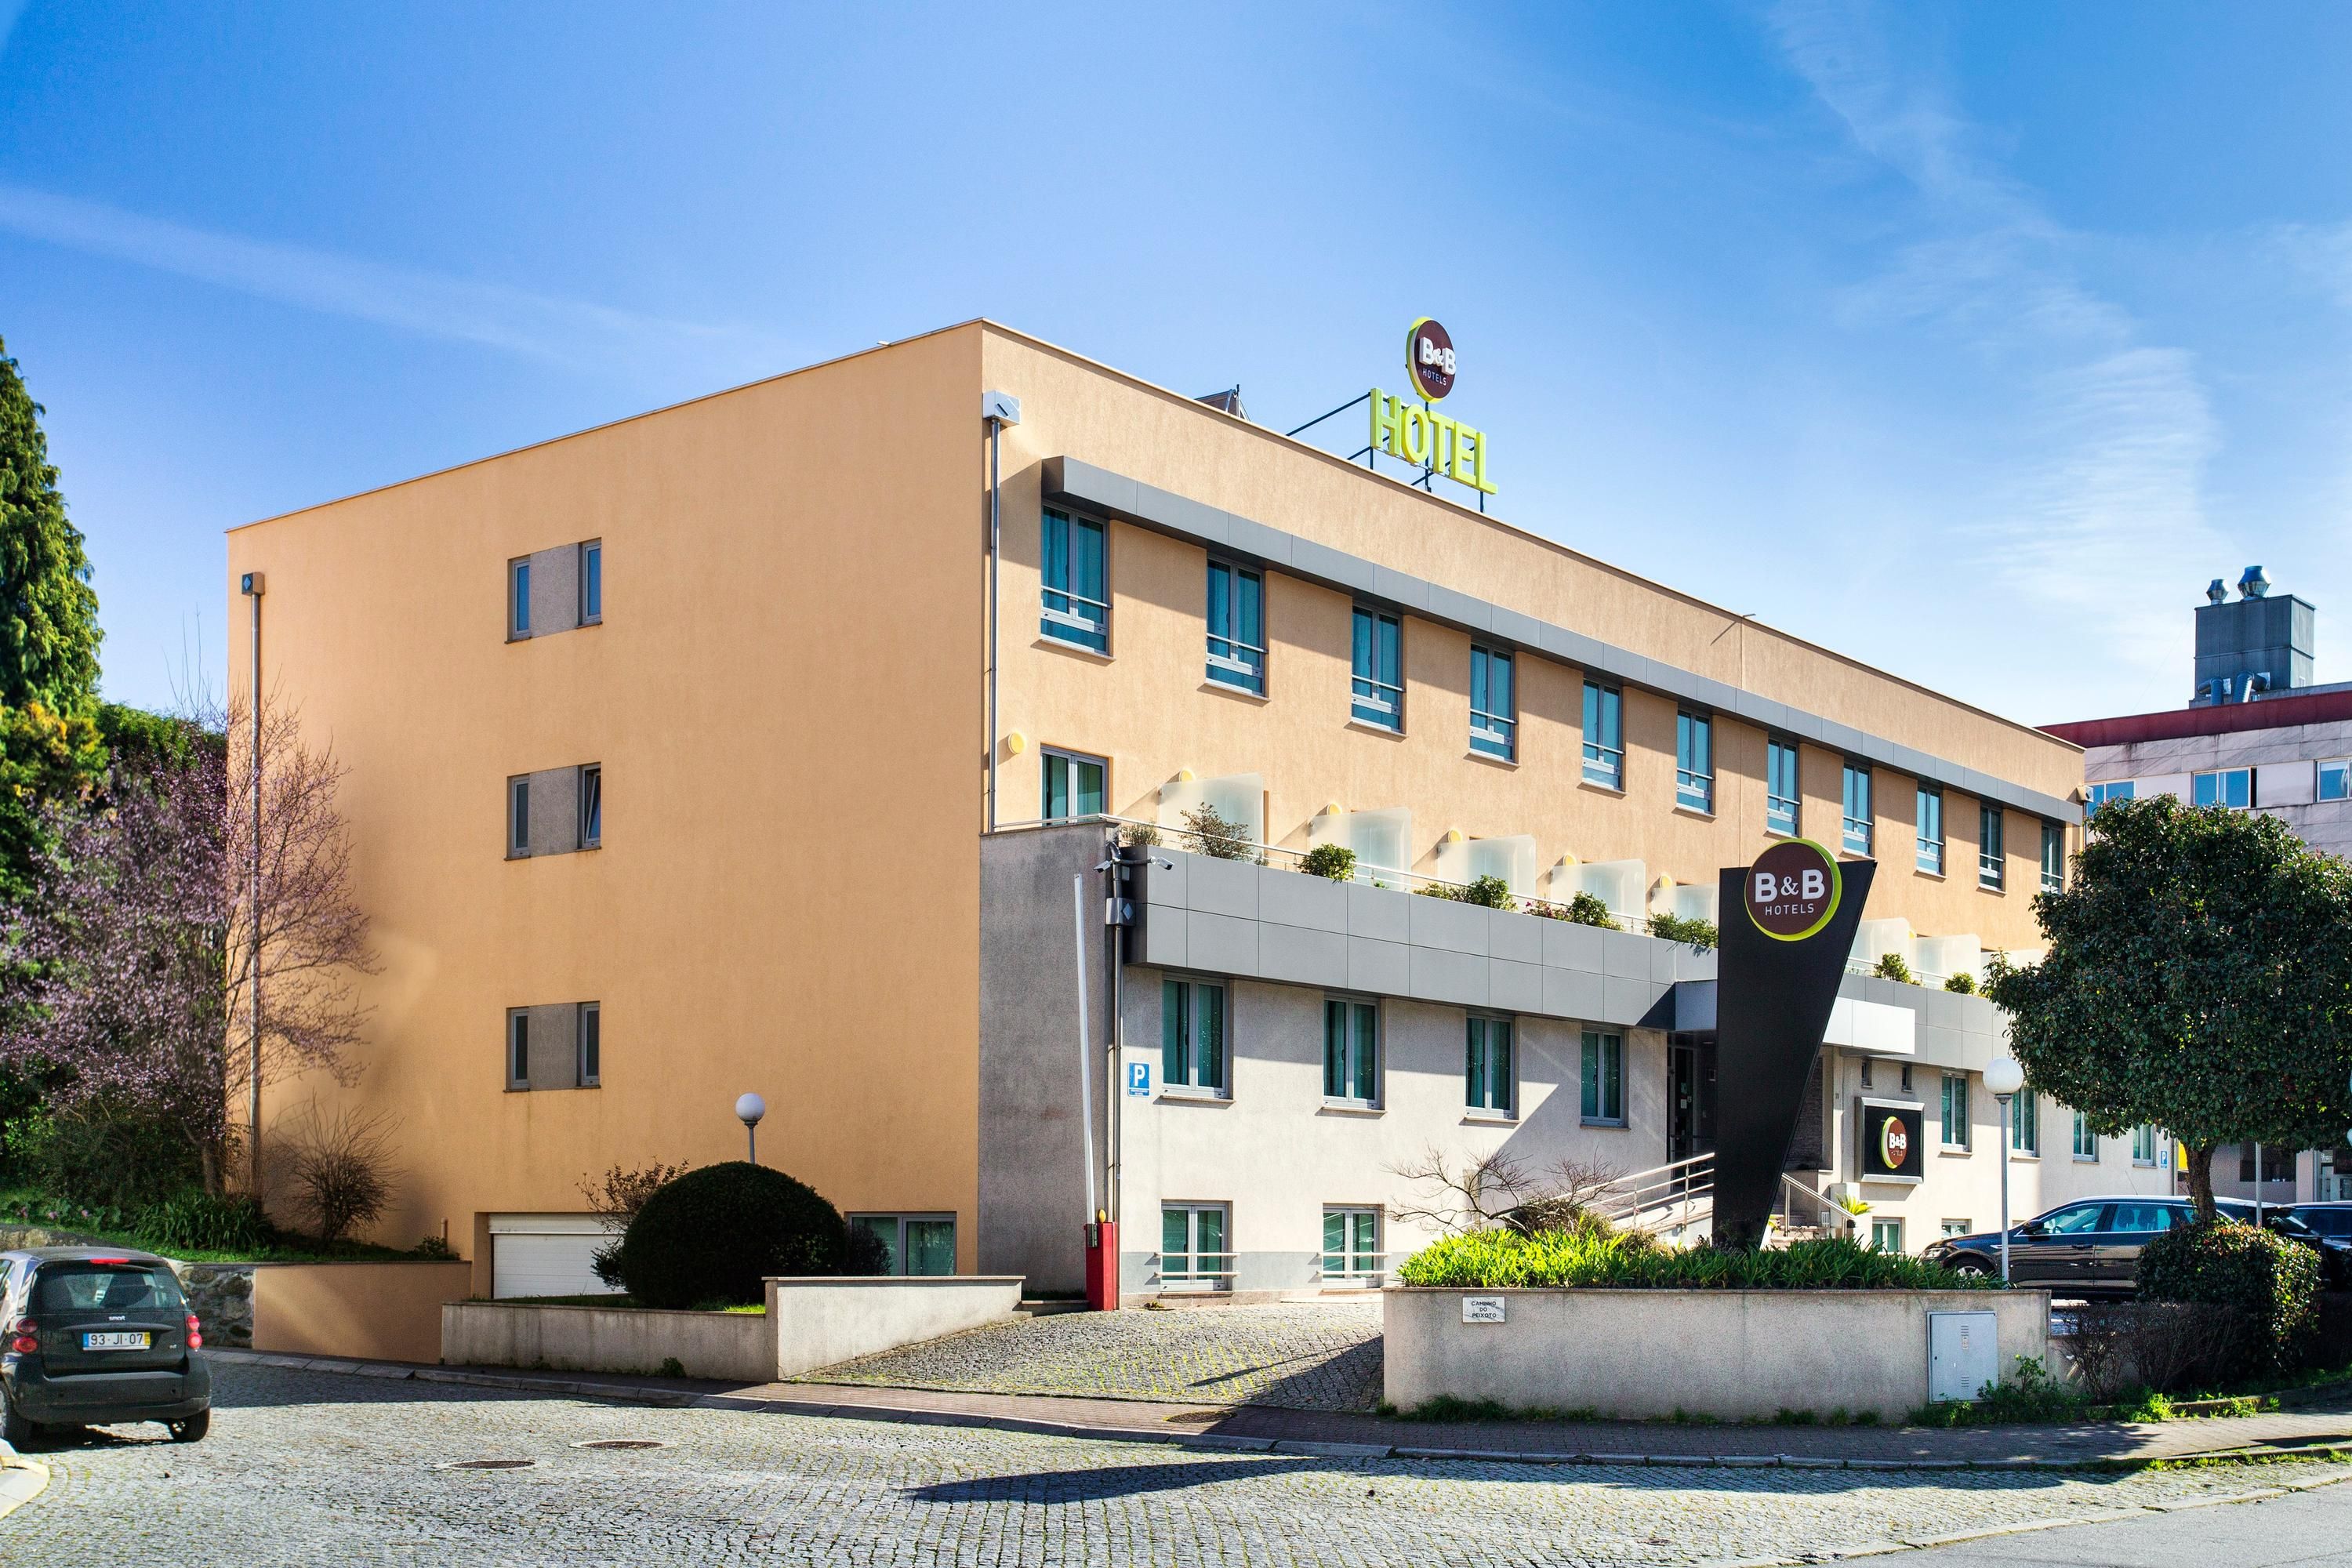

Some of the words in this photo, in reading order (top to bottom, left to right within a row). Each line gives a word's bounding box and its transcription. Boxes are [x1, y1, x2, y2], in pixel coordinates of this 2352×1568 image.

[1419, 336, 1456, 376] B&B
[1422, 368, 1447, 386] HOTELS
[1370, 387, 1498, 495] HOTEL
[1755, 869, 1825, 903] B&B
[1765, 903, 1814, 916] HOTELS
[1134, 1065, 1145, 1087] P
[1889, 1132, 1907, 1149] B&B
[2161, 1152, 2166, 1163] P
